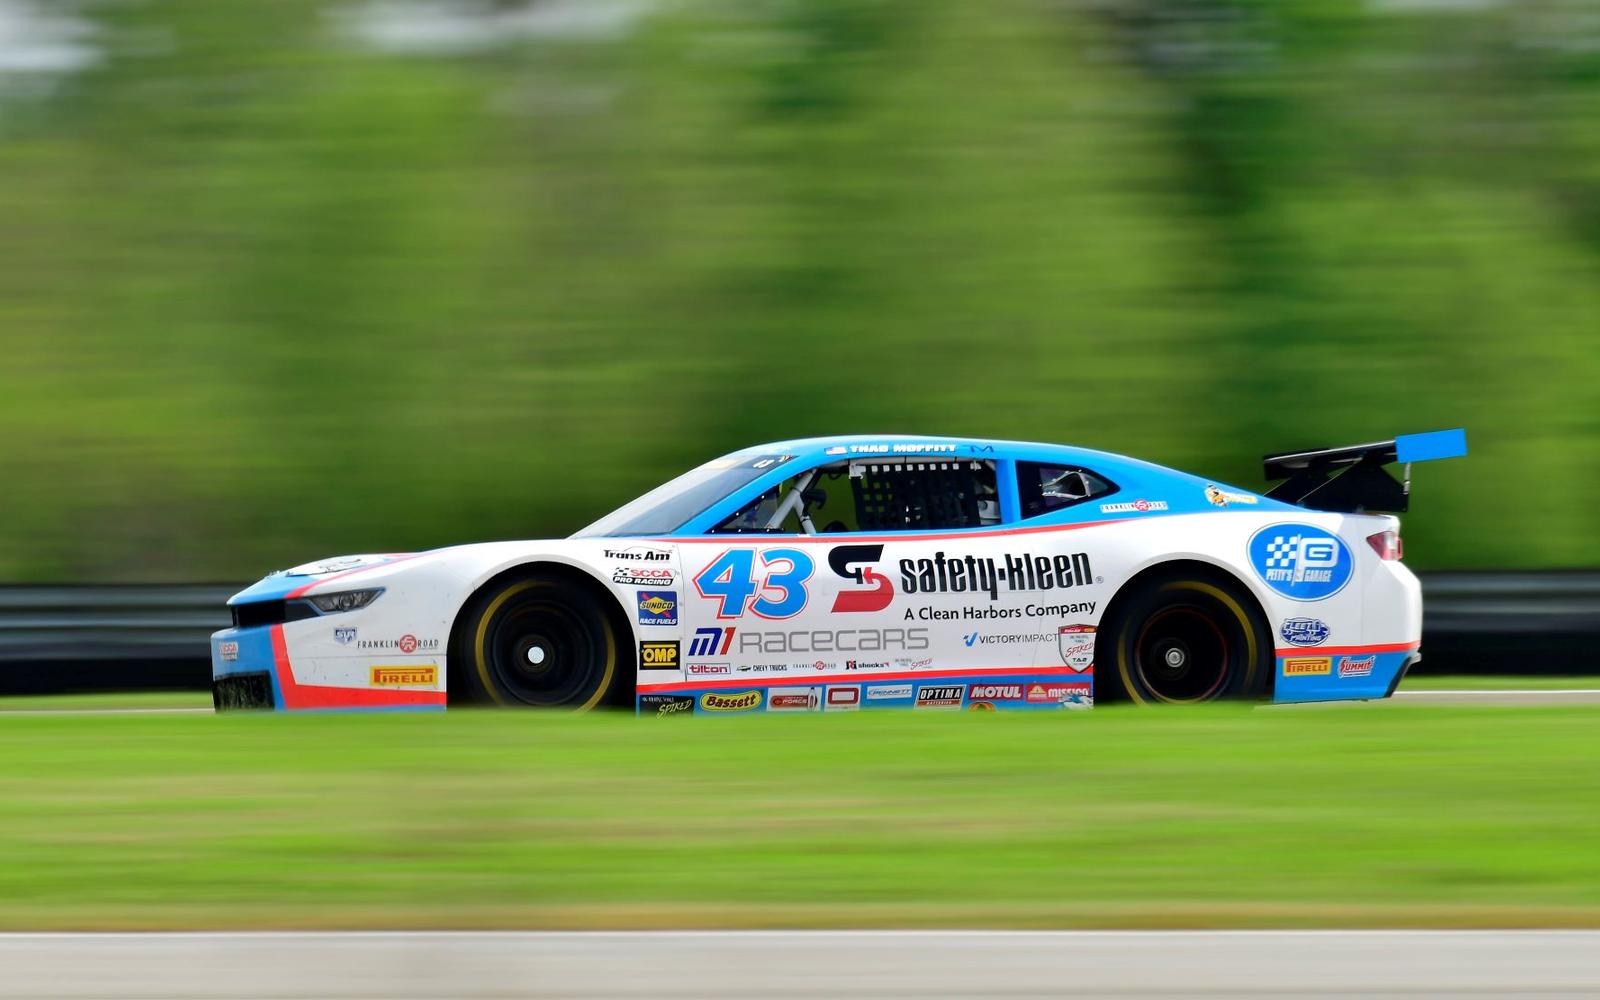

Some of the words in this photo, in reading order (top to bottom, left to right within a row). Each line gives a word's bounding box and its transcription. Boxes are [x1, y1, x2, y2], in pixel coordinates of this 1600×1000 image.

[850, 445, 888, 453] THAD
[893, 444, 957, 453] MOFFITT
[603, 549, 642, 560] Trans
[644, 551, 670, 561] Am
[614, 576, 632, 584] PRO
[630, 569, 672, 578] SCCA
[899, 551, 1094, 600] safety-kleen
[1303, 569, 1333, 583] GARAGE
[693, 547, 816, 620] 43
[640, 601, 673, 610] SUNOCO
[904, 608, 914, 620] A
[918, 607, 959, 620] Clean
[963, 605, 1021, 619] Harbors
[1025, 600, 1097, 618] Company
[357, 640, 399, 649] FRANKLIN
[417, 639, 439, 648] ROAD
[643, 648, 677, 662] OMP
[689, 664, 728, 673] tilton
[1286, 659, 1329, 673] PIRELLI
[374, 668, 434, 684] PIRELLI
[920, 688, 961, 699] OPTIMA
[970, 685, 1022, 698] MOTUL
[706, 694, 757, 708] Bassett
